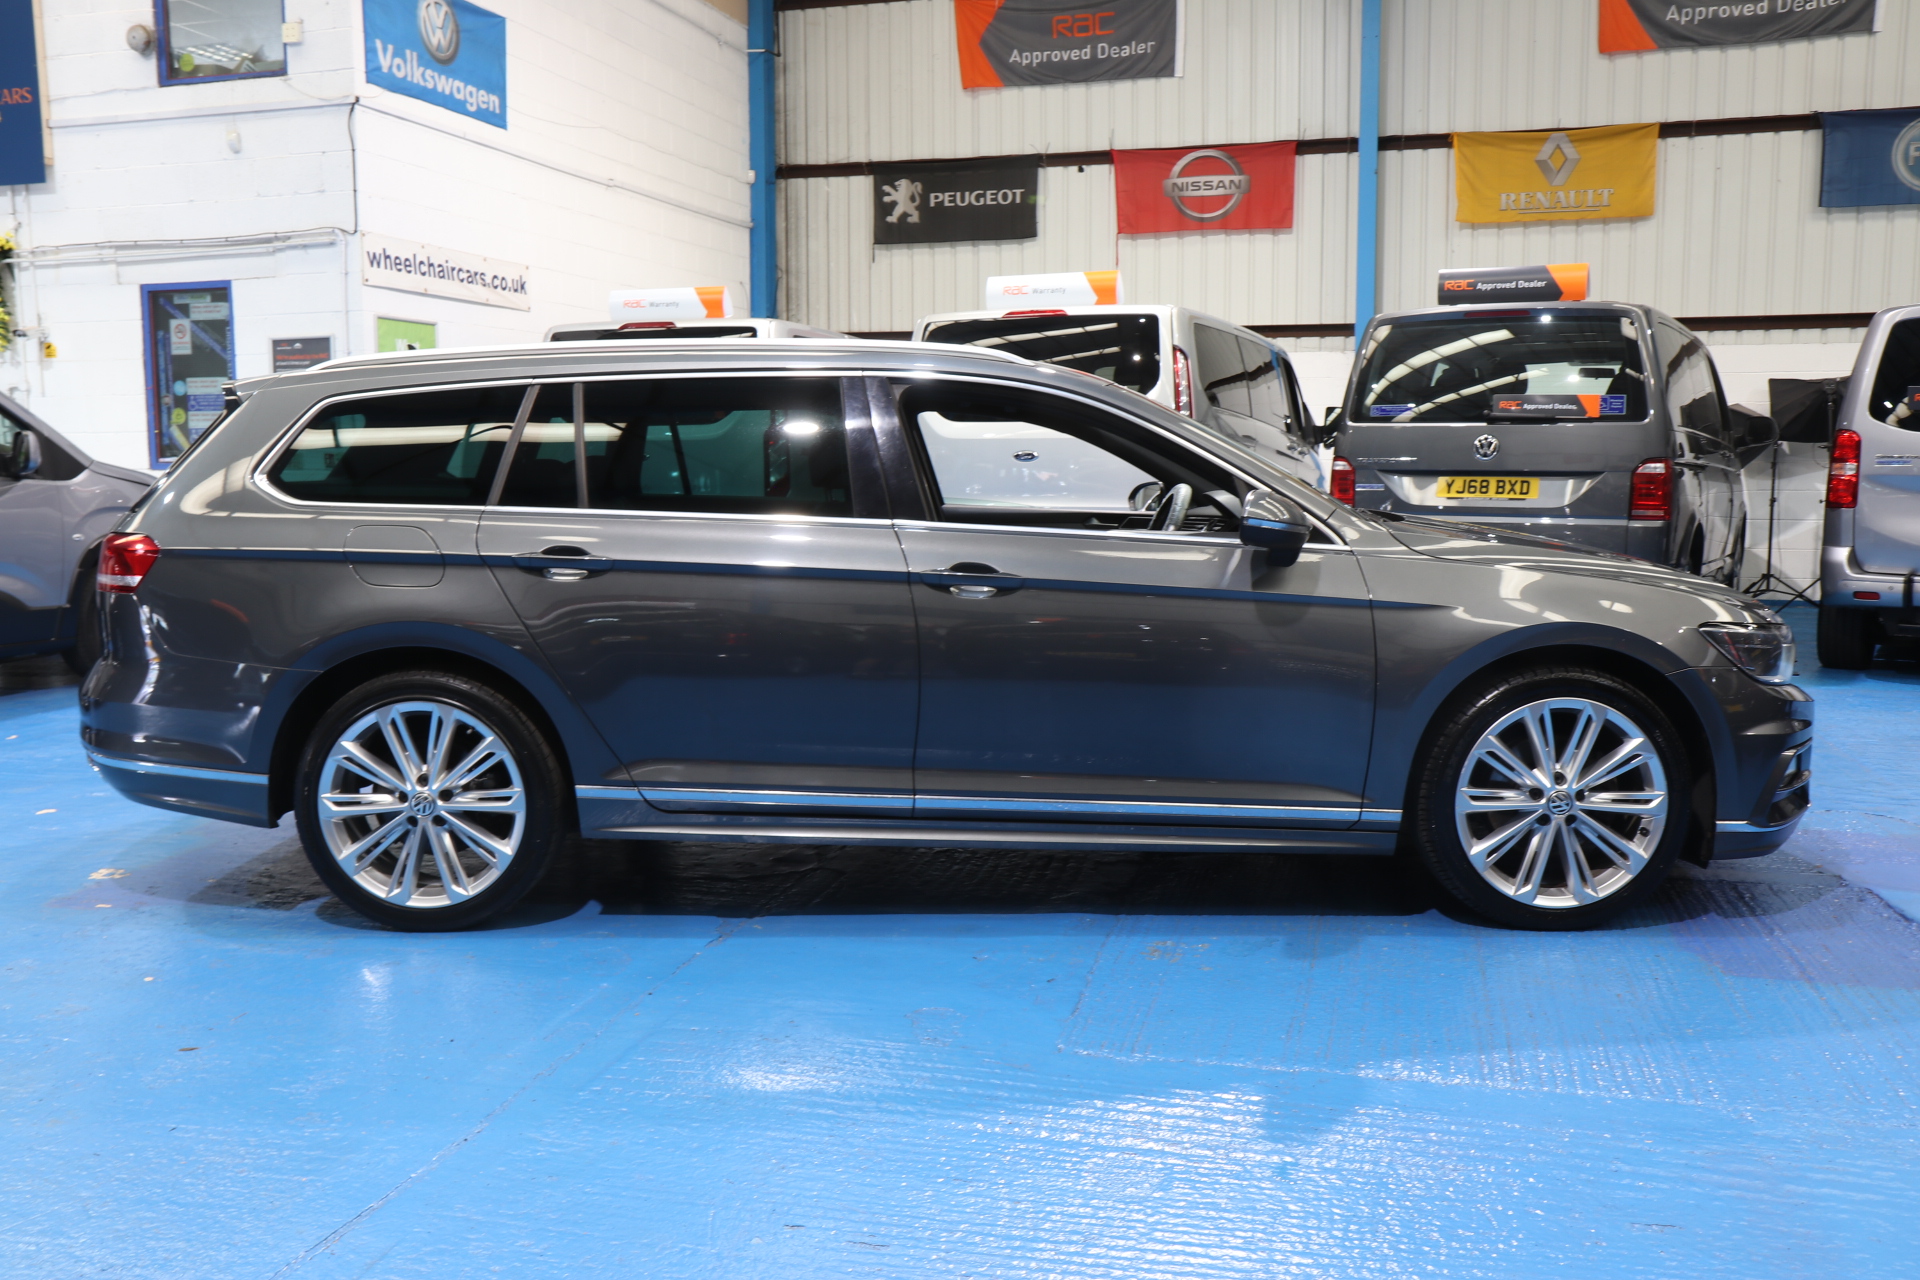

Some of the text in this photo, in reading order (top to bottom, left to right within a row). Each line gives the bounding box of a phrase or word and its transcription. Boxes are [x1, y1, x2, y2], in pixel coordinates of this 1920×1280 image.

[1666, 1, 1769, 25] Approved
[1009, 41, 1156, 67] Approved Dealer
[375, 39, 501, 114] Volkswagen
[1172, 180, 1242, 193] NISSAN
[929, 188, 1026, 207] PEUGEOT
[1498, 188, 1615, 211] RENAULT
[366, 247, 528, 295] wheelchaircars.co.uk
[1032, 286, 1067, 295] Warranty
[1476, 281, 1517, 292] Approved
[1518, 279, 1548, 289] Dealer
[649, 300, 680, 309] Warranty
[1523, 403, 1553, 411] Approved
[1445, 479, 1531, 495] YJ68 BXD
